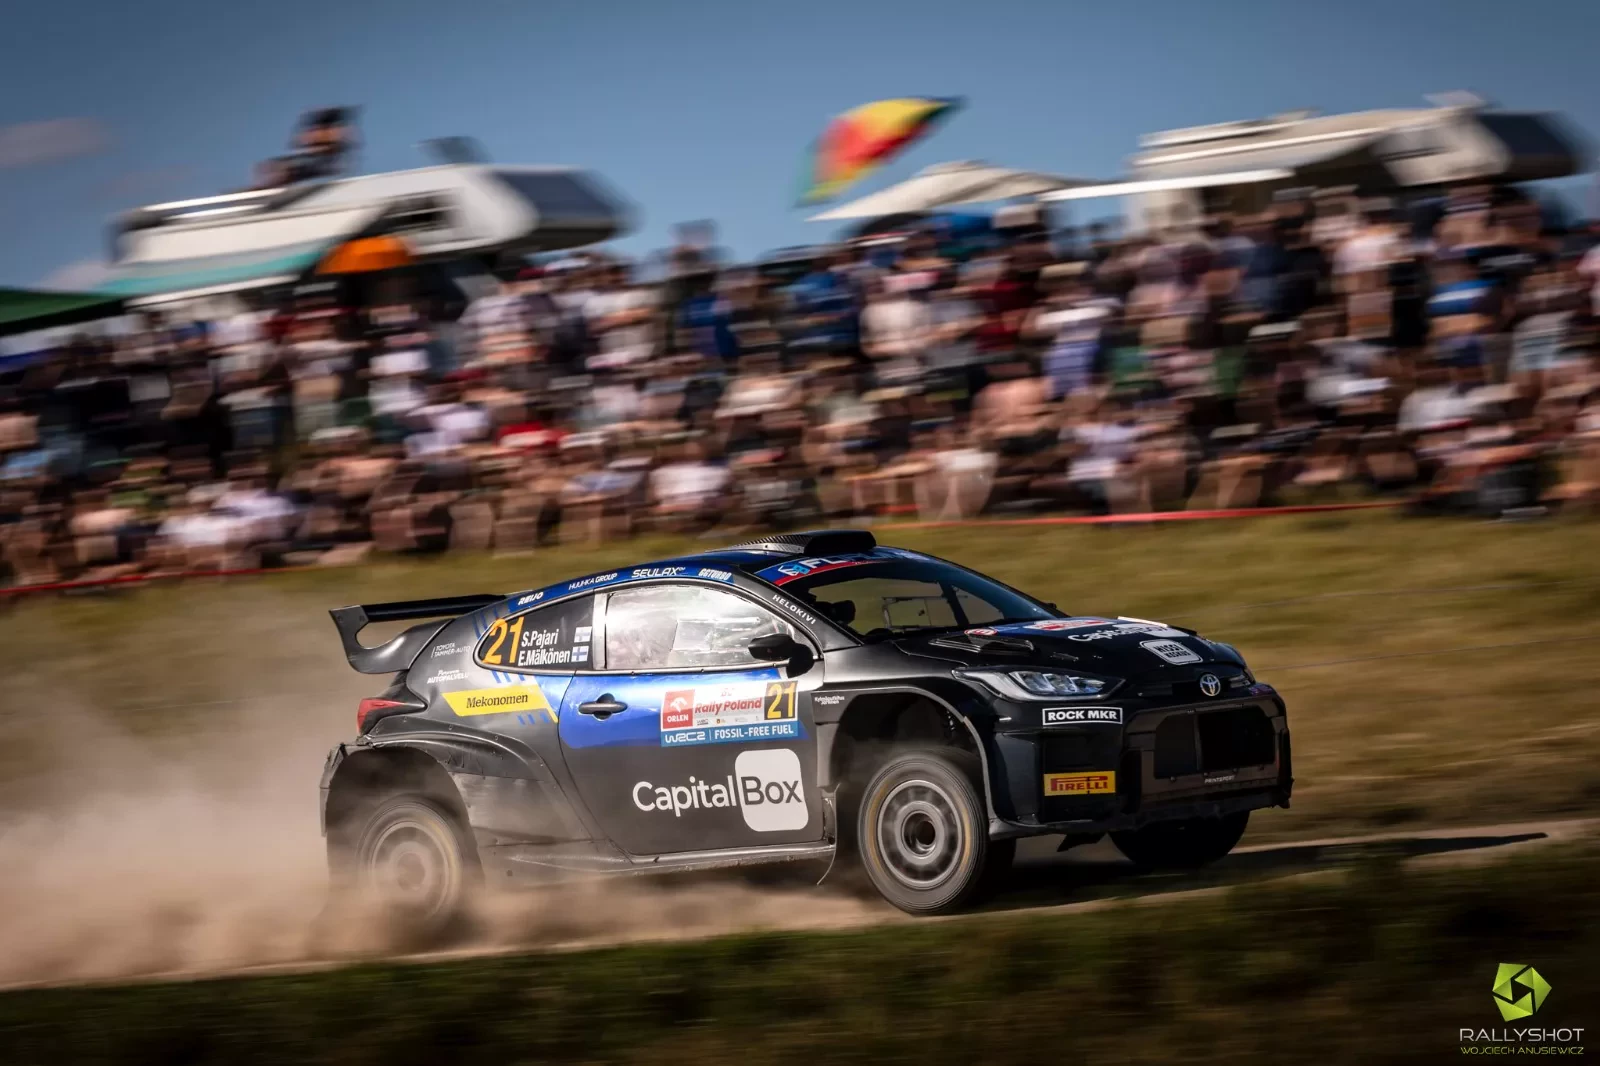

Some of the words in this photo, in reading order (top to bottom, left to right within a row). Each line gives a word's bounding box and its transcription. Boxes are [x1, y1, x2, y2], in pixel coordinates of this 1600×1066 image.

[595, 572, 618, 584] GROUP
[631, 567, 678, 578] SEULAX
[773, 594, 816, 625] HELOKIVI
[436, 642, 455, 651] TOYOTA
[482, 616, 525, 665] 21
[521, 629, 560, 648] S.Pajari
[518, 648, 571, 667] E.Mälkönen
[466, 694, 528, 708] Mekonomen
[695, 701, 723, 716] Rally
[723, 697, 763, 711] Poland
[767, 682, 798, 720] 21
[666, 713, 689, 723] ORLEN
[1048, 710, 1085, 721] ROCK
[1087, 709, 1118, 721] MKR
[665, 730, 706, 744] WRC2
[714, 726, 770, 740] FOSSIL-FREE
[772, 724, 794, 736] FUEL
[1050, 775, 1108, 792] PIRELLI
